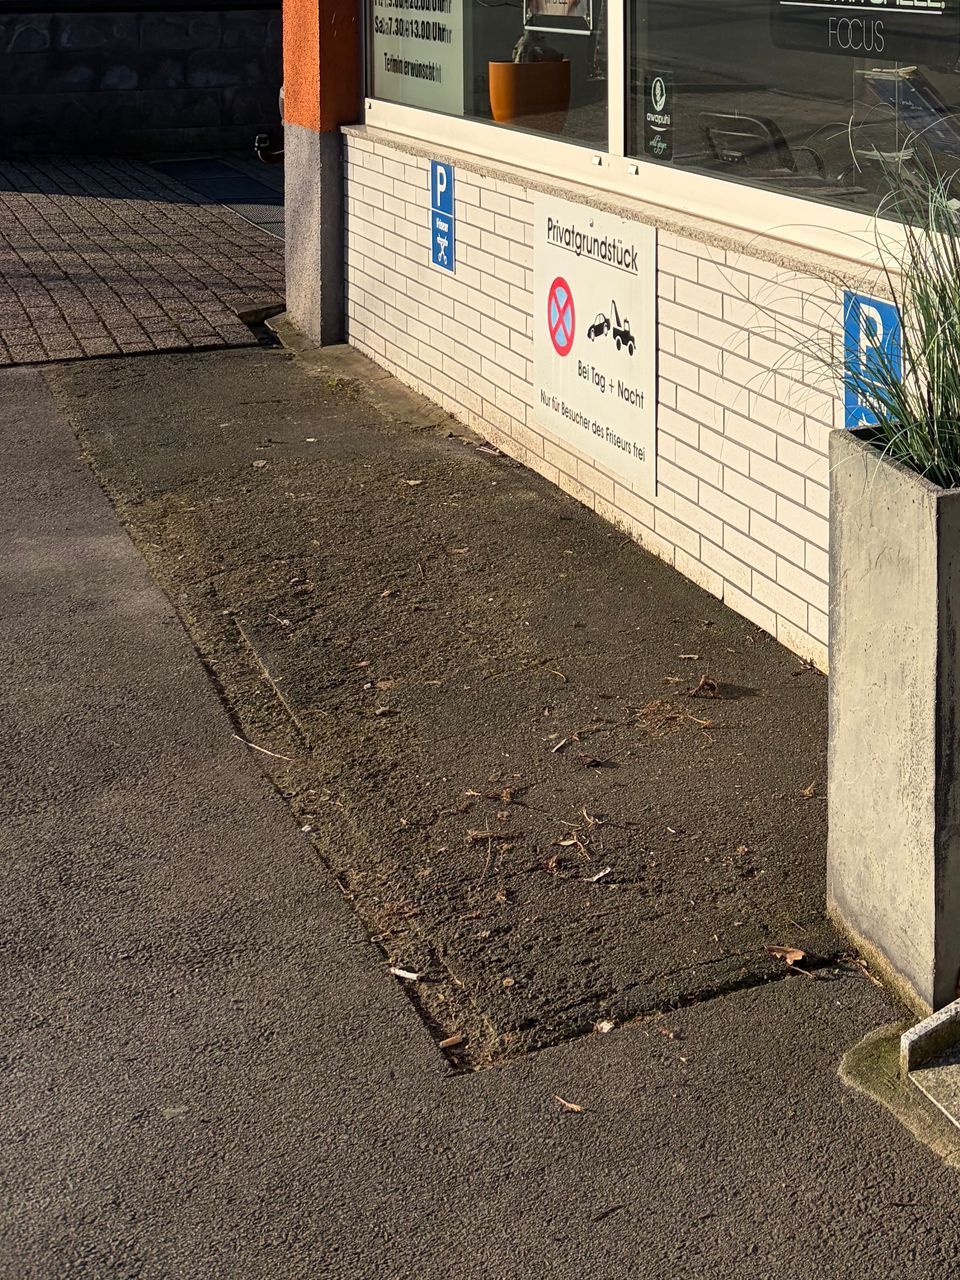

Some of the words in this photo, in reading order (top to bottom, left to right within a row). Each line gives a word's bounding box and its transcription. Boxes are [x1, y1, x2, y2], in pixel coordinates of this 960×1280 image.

[432, 22, 445, 43] Uhr
[828, 17, 885, 52] FOCUS
[383, 52, 403, 74] Termin
[403, 59, 435, 82] erwünscht
[436, 165, 447, 207] P
[547, 216, 639, 271] Privatgrundstück
[859, 302, 884, 375] P
[577, 360, 590, 378] Bei
[591, 366, 606, 394] Tag
[609, 382, 615, 395] +
[617, 382, 644, 409] Nacht
[540, 389, 551, 407] Nur
[551, 396, 560, 413] für
[561, 401, 590, 431] Besucher
[591, 416, 604, 439] des
[605, 428, 631, 455] Friseurs
[633, 442, 646, 462] frei
